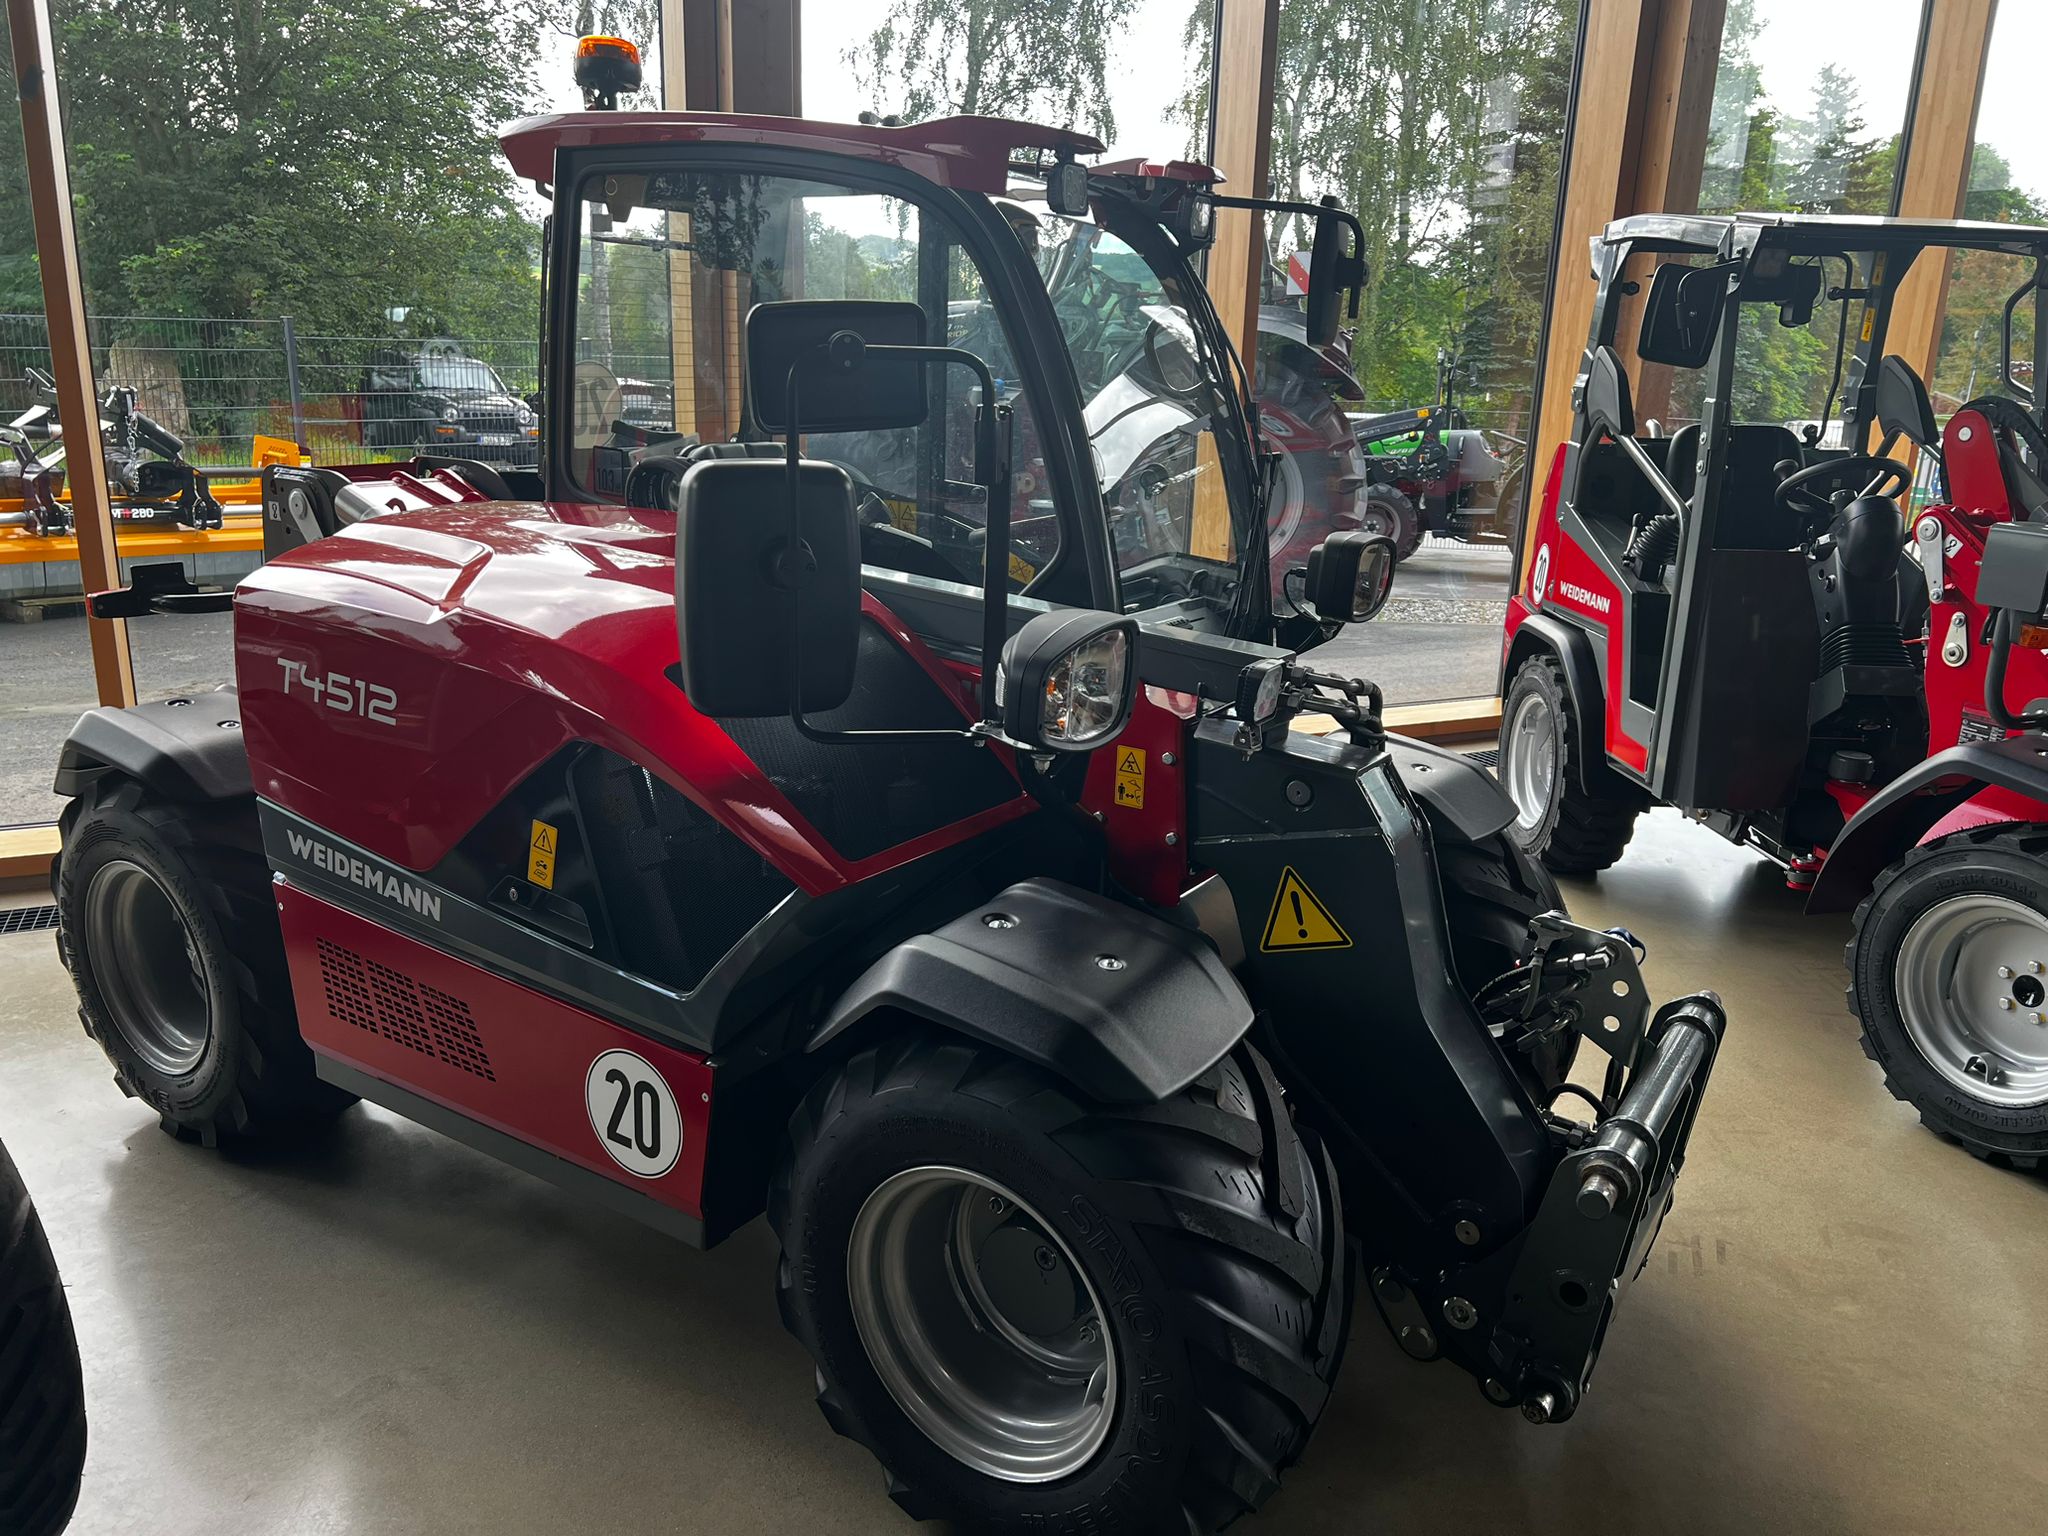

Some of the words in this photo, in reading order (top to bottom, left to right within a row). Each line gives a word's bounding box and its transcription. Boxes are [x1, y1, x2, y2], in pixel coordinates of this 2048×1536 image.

[1534, 553, 1548, 595] 20
[1560, 580, 1611, 614] WEIDEMANN
[277, 657, 398, 726] T4512
[286, 828, 442, 922] WEIDEMANN
[605, 1068, 661, 1159] 20
